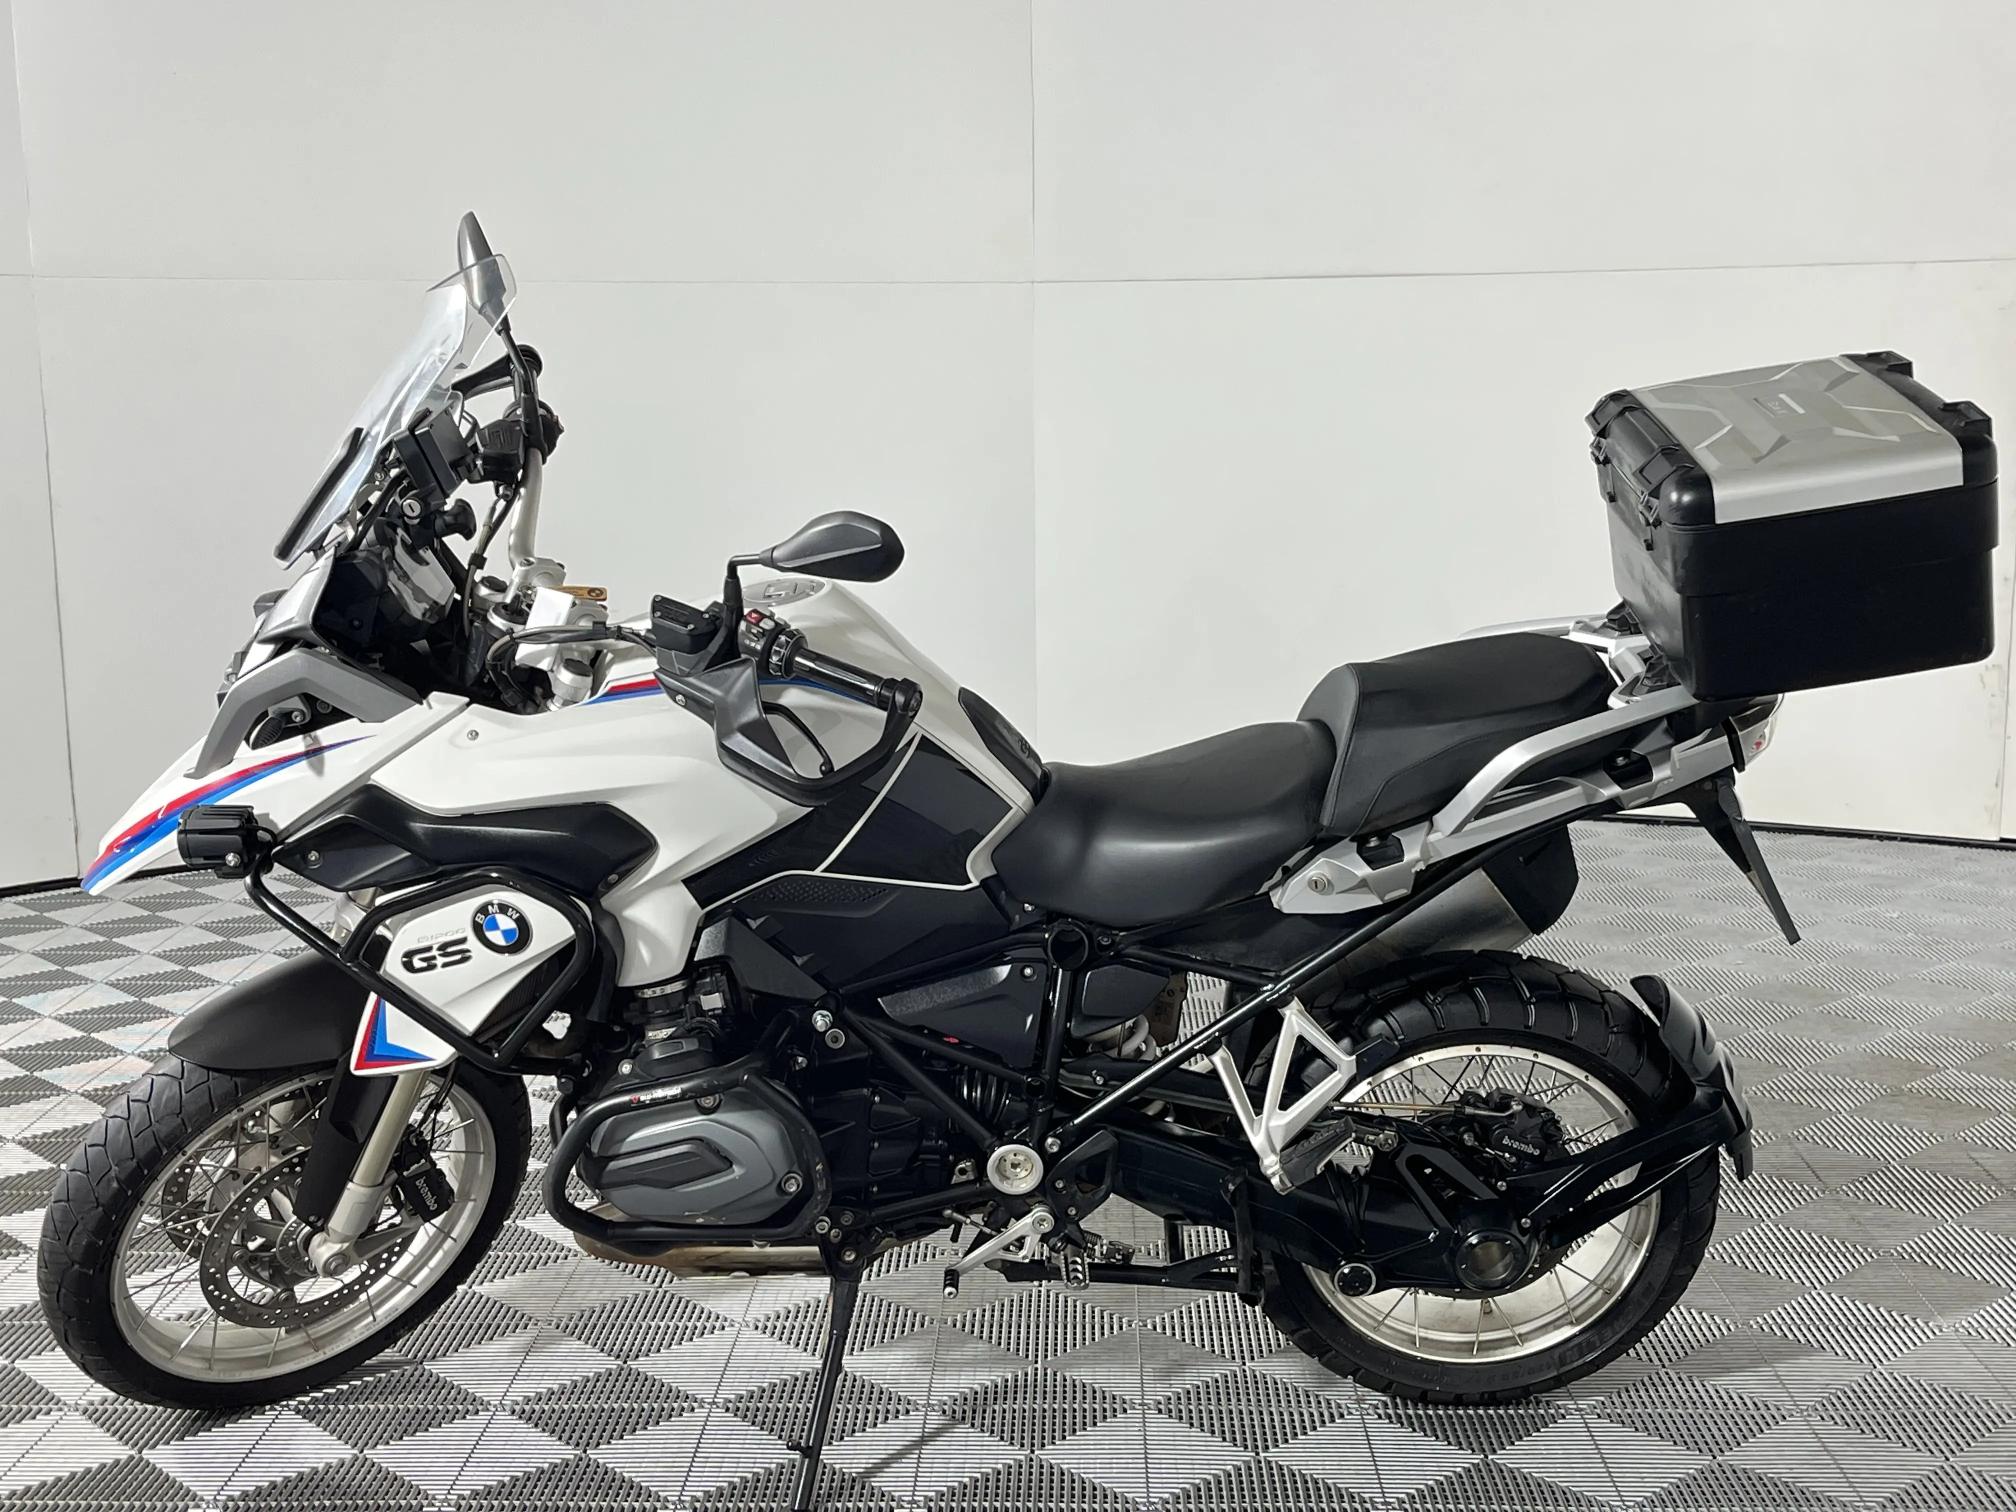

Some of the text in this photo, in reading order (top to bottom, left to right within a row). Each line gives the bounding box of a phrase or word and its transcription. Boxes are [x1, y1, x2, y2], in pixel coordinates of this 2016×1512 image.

[475, 904, 520, 924] BMW
[401, 936, 472, 973] GS
[1502, 1135, 1540, 1156] brembo
[416, 1176, 438, 1210] brembo
